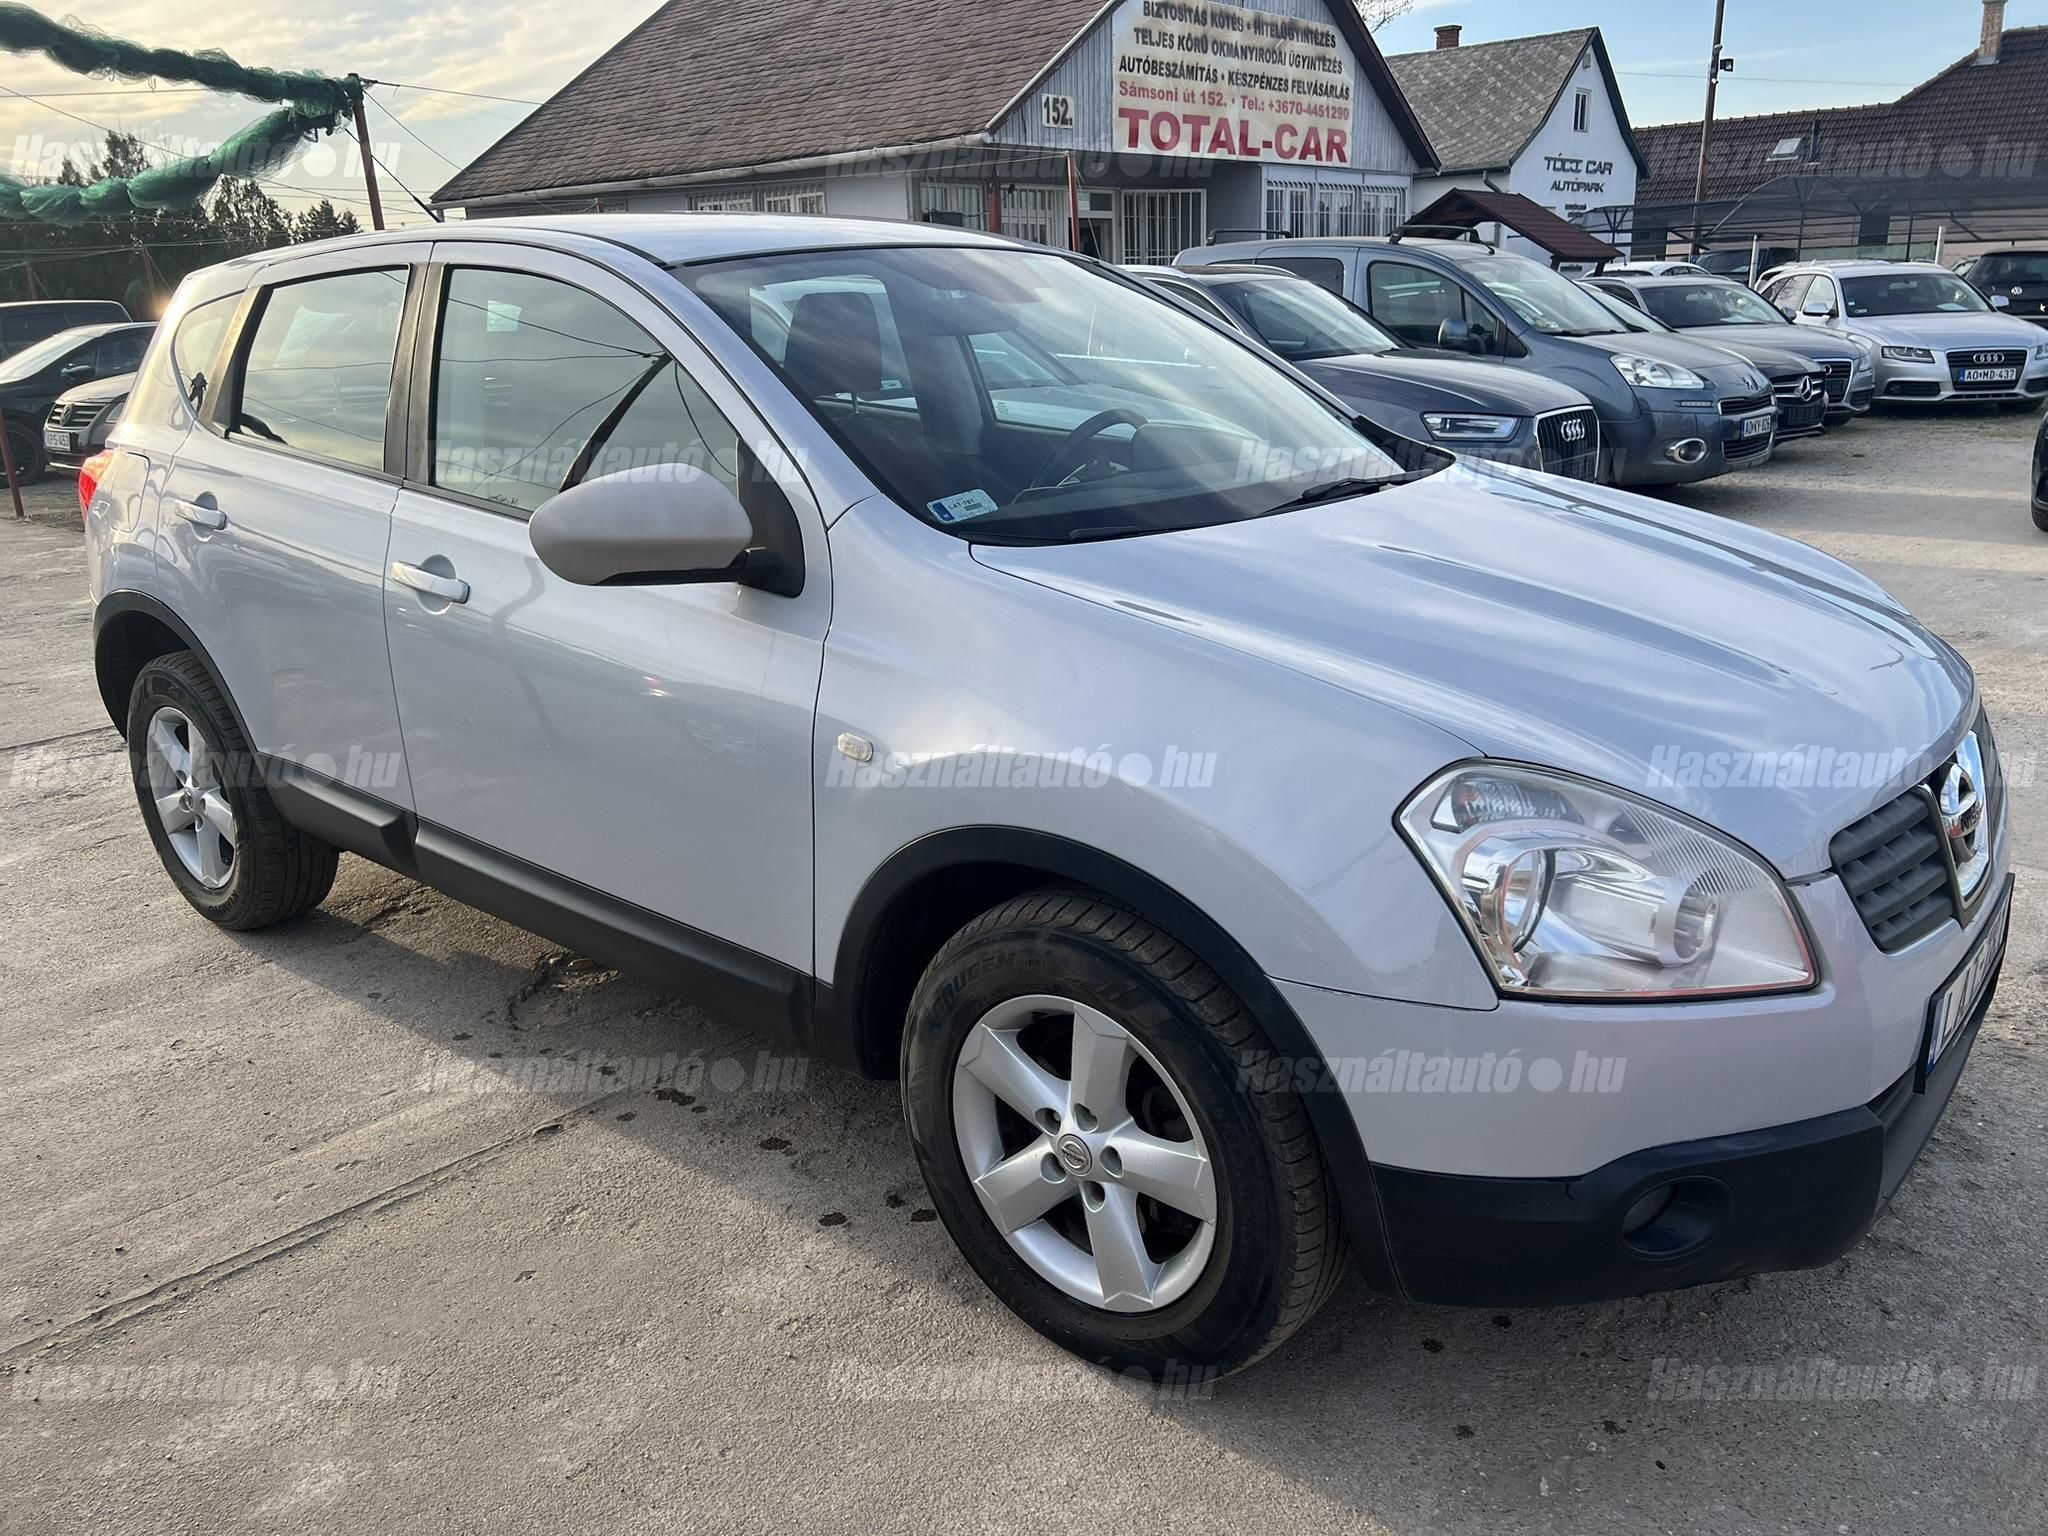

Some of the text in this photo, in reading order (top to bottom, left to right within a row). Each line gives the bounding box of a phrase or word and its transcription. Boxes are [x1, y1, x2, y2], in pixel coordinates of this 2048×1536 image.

[1143, 1, 1207, 27] BIZTOSÍTÁS
[1134, 28, 1174, 49] TELJES
[1212, 40, 1286, 66] OKMÁNYIRODAI
[1289, 50, 1343, 75] ÜGYINTÉZÉS
[1119, 55, 1350, 100] AUTÓBESZÁMÍTÁS KÉSZPÉNZES FELVÁSÁRLÁS
[1044, 96, 1073, 126] 152.
[1119, 81, 1349, 120] Sámsoni út 152. Tel.: +3670-4451290
[1118, 107, 1348, 163] TOTAL-CAR
[1586, 160, 1613, 175] CAR
